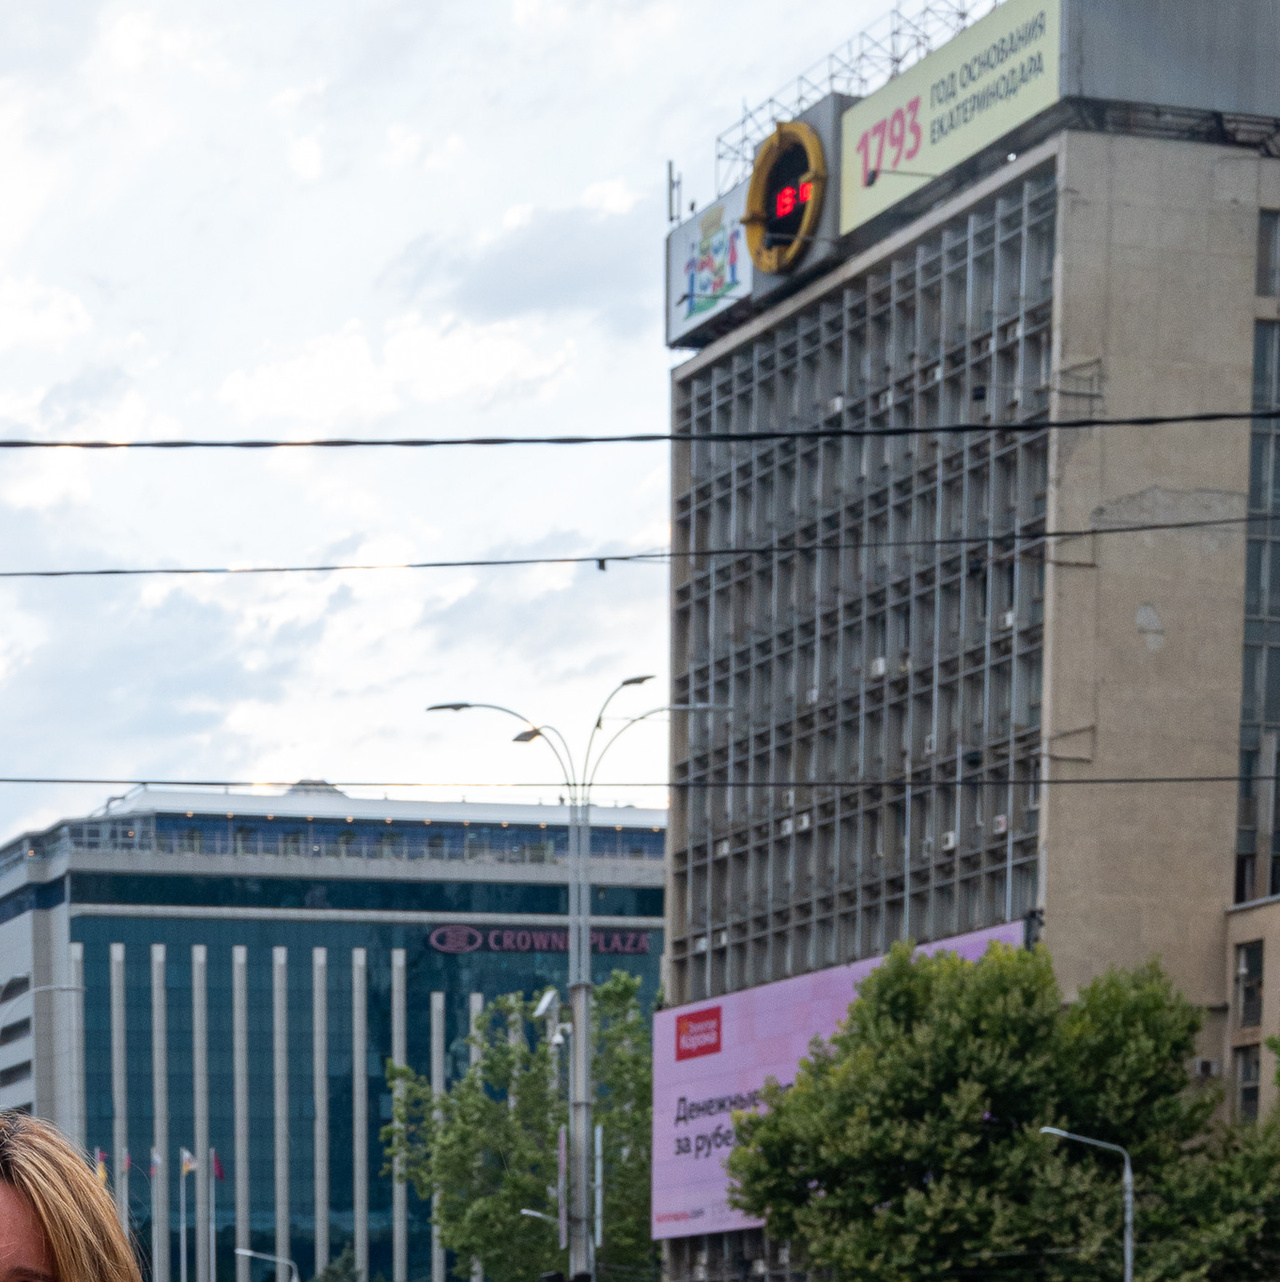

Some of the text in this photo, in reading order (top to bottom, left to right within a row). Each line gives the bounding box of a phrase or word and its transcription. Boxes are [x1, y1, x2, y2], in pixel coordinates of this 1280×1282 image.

[929, 9, 1045, 109] ГОД ОСНОВАНИЯ
[929, 50, 1044, 145] ЕКАТЕРИНОДАРА
[857, 95, 922, 188] 1793
[674, 1122, 736, 1159] за рубе
